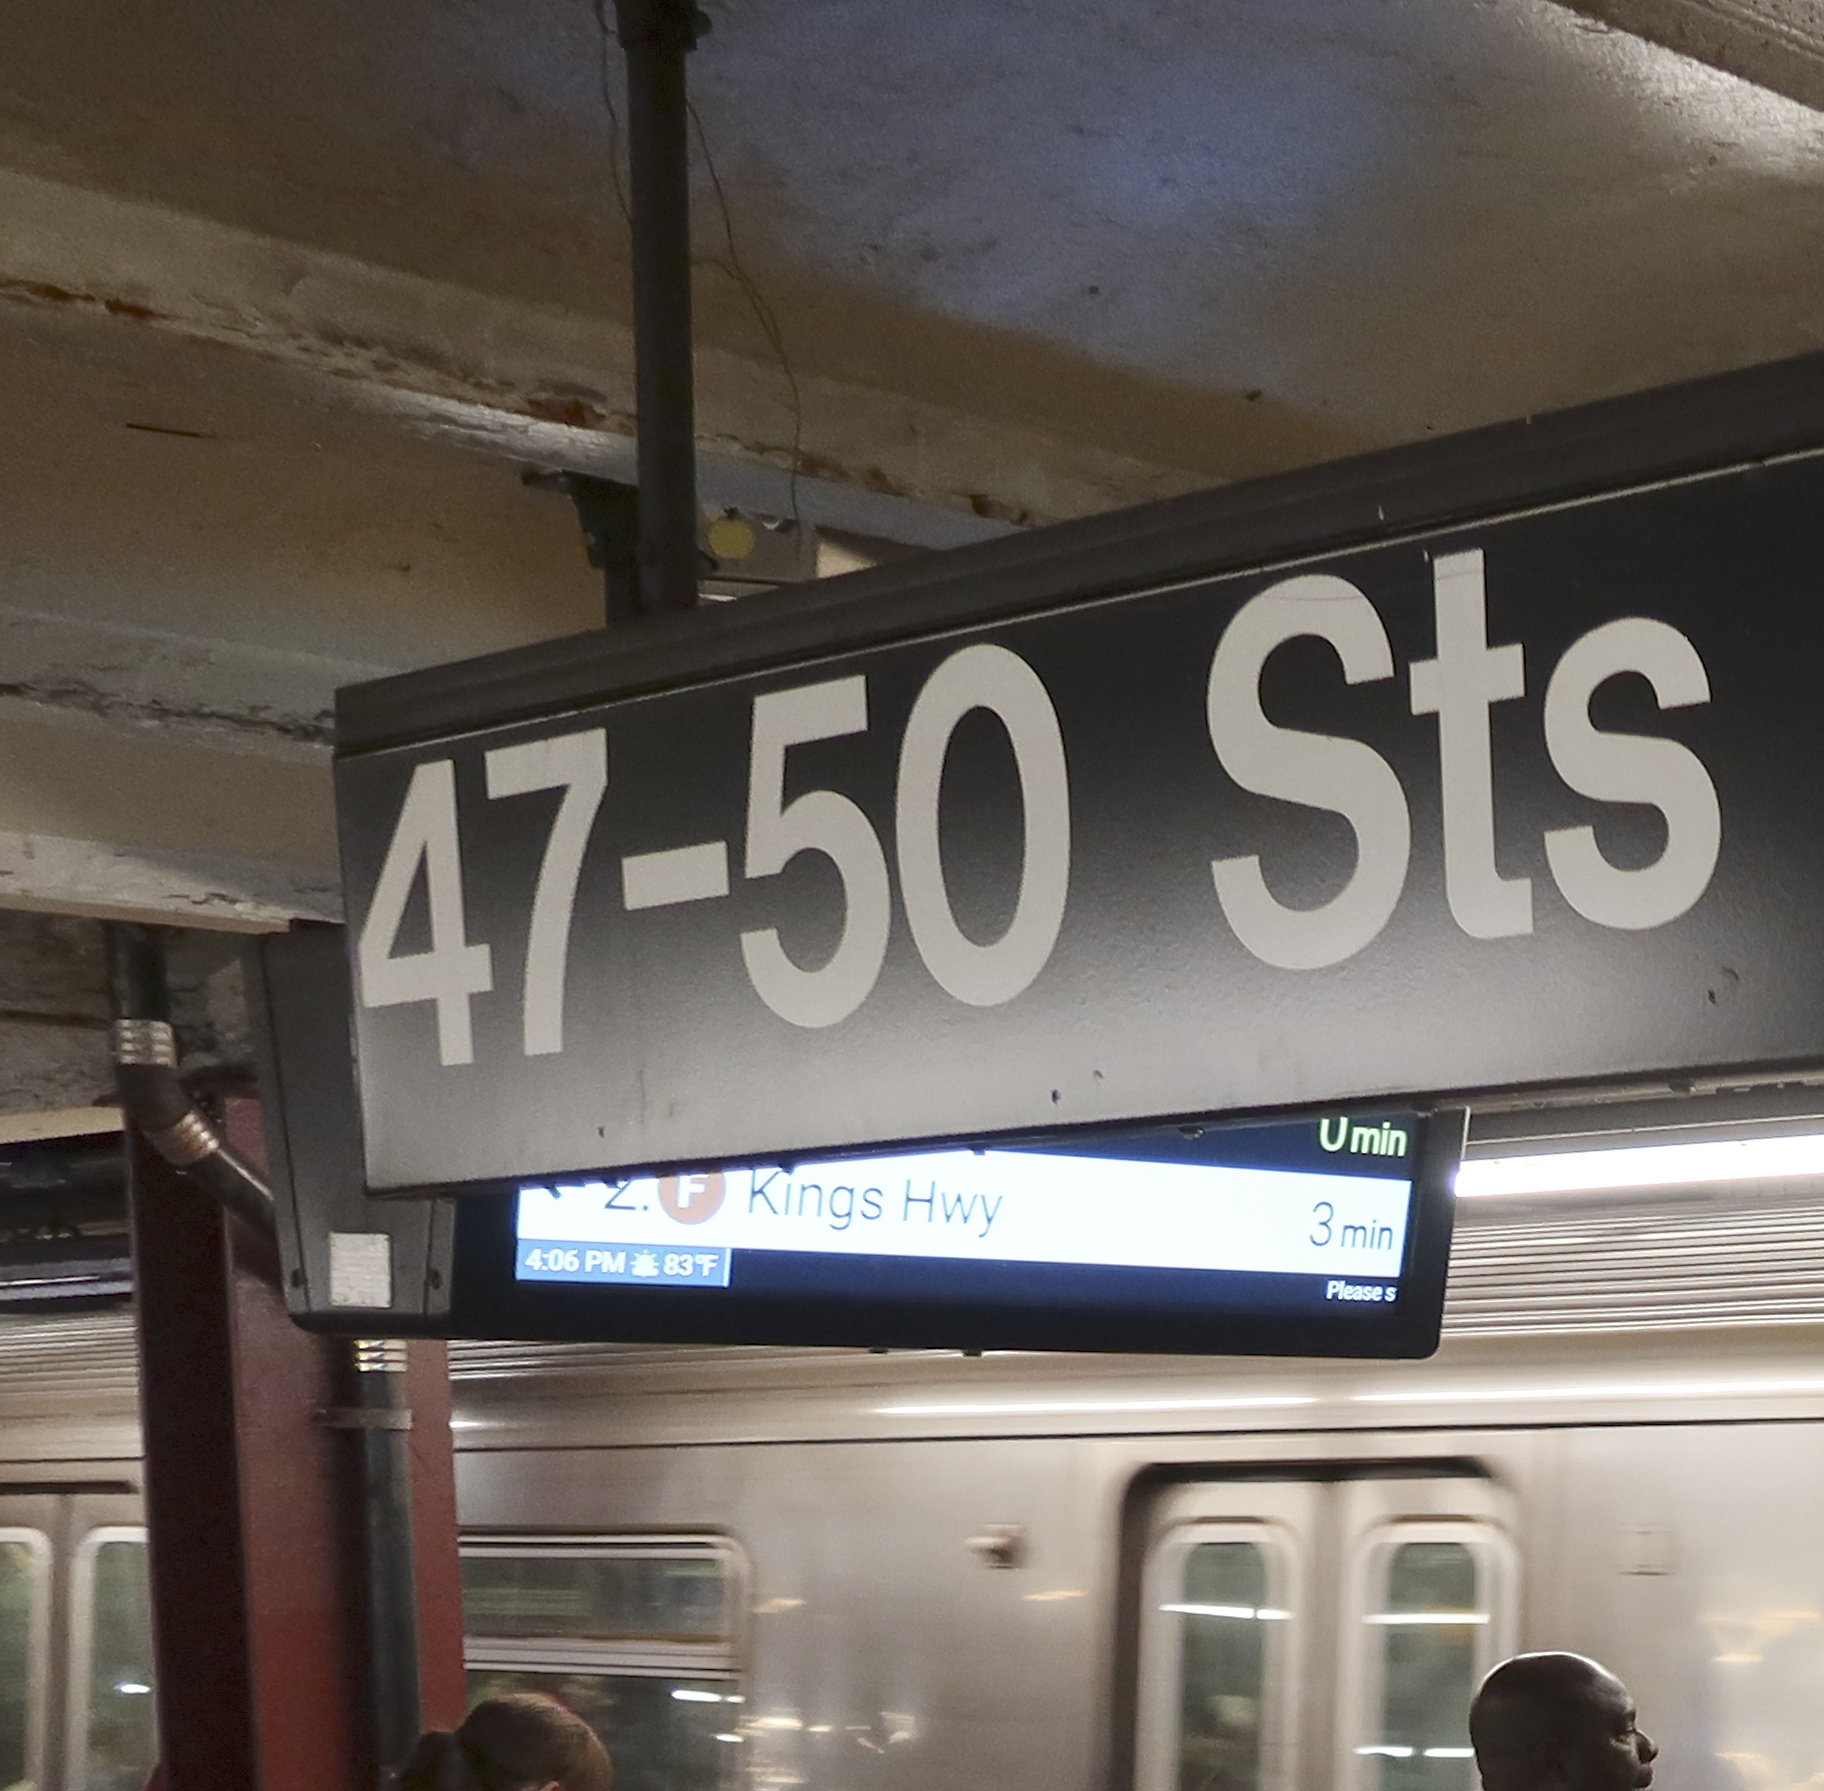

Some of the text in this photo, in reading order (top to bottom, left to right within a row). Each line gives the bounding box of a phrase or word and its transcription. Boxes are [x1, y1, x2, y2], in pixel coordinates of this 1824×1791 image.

[356, 643, 1071, 1067] 47-50
[1206, 547, 1724, 972] Sts
[1350, 1121, 1408, 1157] min
[677, 1174, 709, 1209] F
[748, 1168, 884, 1231] Kings
[902, 1168, 1003, 1238] Hwy
[1309, 1201, 1334, 1247] 3
[1340, 1218, 1394, 1250] min
[524, 1249, 580, 1272] 4:06
[584, 1250, 627, 1274] PM
[1326, 1280, 1382, 1302] Please
